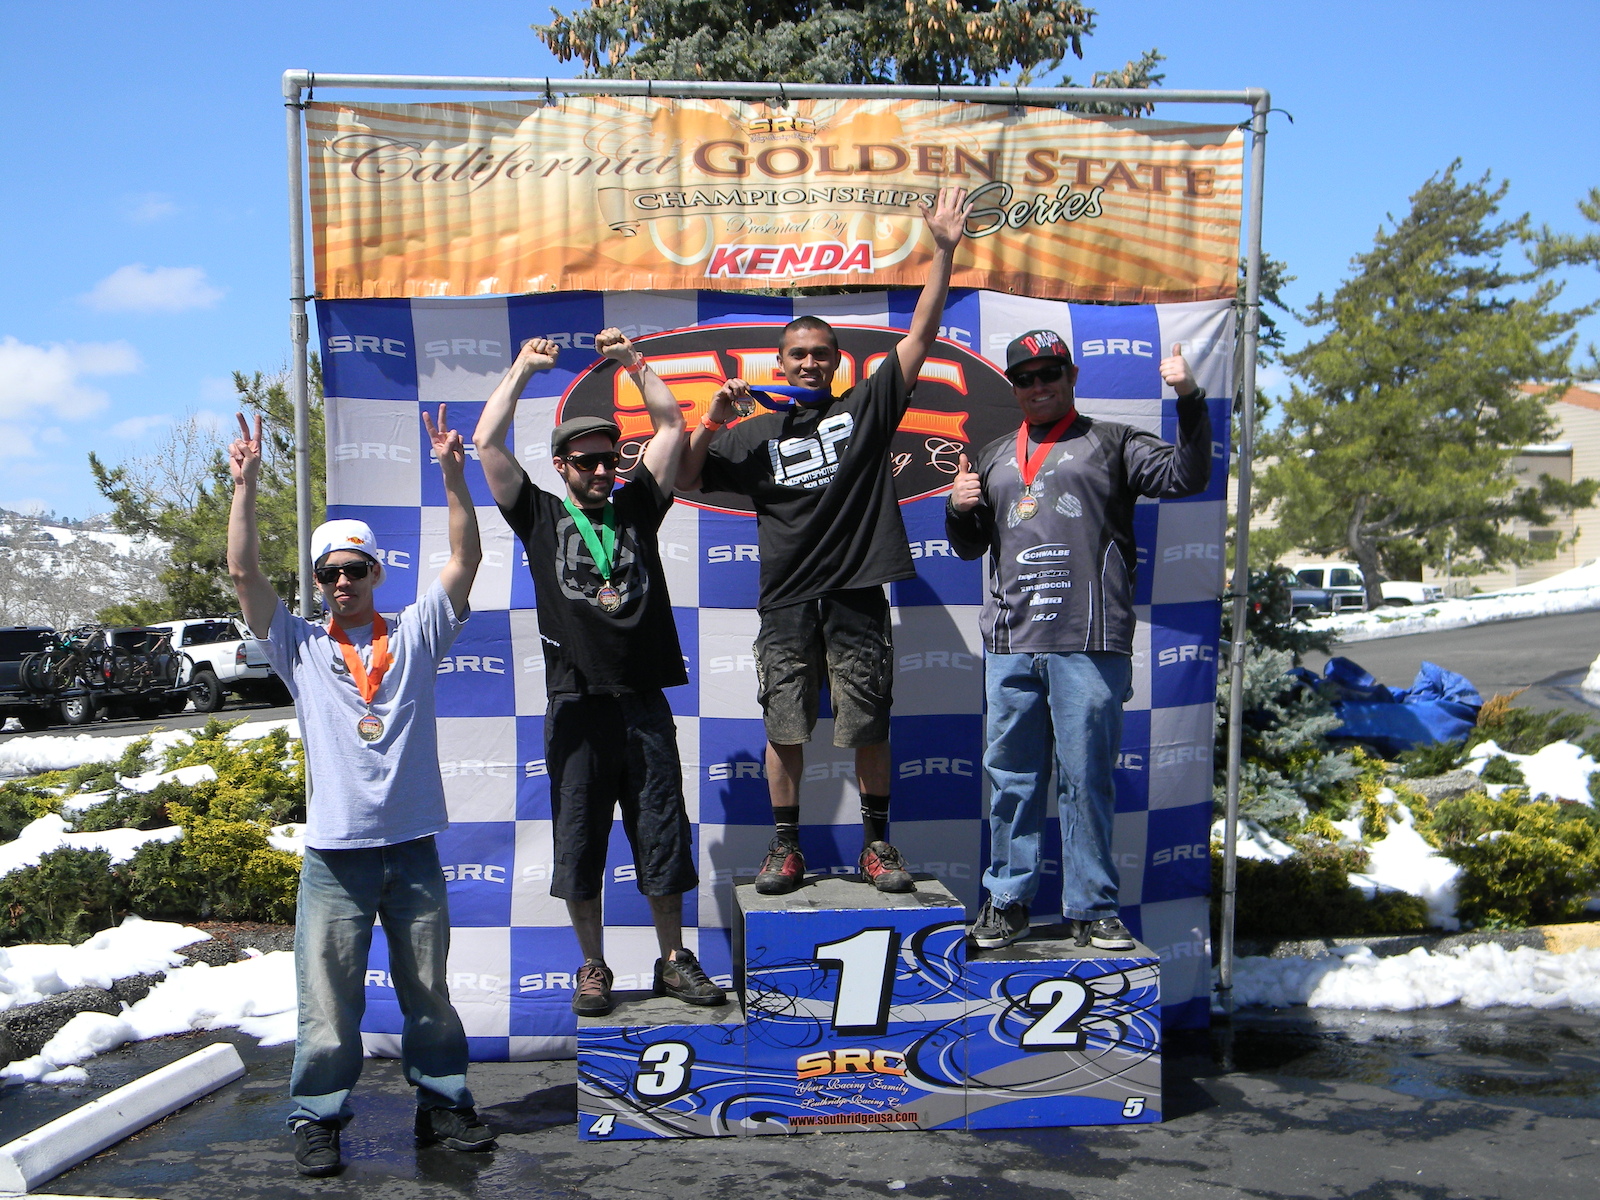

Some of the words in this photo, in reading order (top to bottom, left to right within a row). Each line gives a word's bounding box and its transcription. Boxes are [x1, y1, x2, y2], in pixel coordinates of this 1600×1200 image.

[748, 117, 816, 135] SRC
[332, 134, 676, 195] California
[693, 140, 999, 181] GOLDEN
[1023, 147, 1216, 198] STATE
[633, 186, 936, 211] CHAMPIONSHIPS
[962, 181, 1105, 238] Series
[726, 213, 812, 235] Presented
[812, 211, 849, 236] By
[706, 242, 873, 276] KENDA
[328, 335, 406, 358] SRC
[425, 338, 502, 358] SRC
[1082, 338, 1153, 358] SRC
[335, 442, 412, 464] SRC
[708, 544, 761, 564] SR
[1024, 549, 1071, 560] SCHWALBE
[1163, 543, 1220, 564] SRC
[710, 653, 758, 674] SR
[899, 650, 973, 672] SRC
[1158, 645, 1213, 668] SRC
[708, 761, 767, 782] SR
[805, 761, 857, 782] SR
[899, 757, 973, 779] SRC
[1153, 844, 1206, 866] SRC
[519, 972, 577, 993] SR
[815, 928, 894, 1029] 1
[1021, 979, 1088, 1047] 2
[635, 1041, 692, 1098] 3
[796, 1047, 908, 1080] SRC
[795, 1077, 824, 1096] Your
[826, 1078, 866, 1092] Racing
[867, 1077, 909, 1096] Family
[800, 1097, 851, 1109] Southridge
[850, 1094, 884, 1109] Racing
[1122, 1096, 1146, 1118] 5
[588, 1113, 617, 1136] 4
[789, 1112, 918, 1127] www.southridgeusa.com
